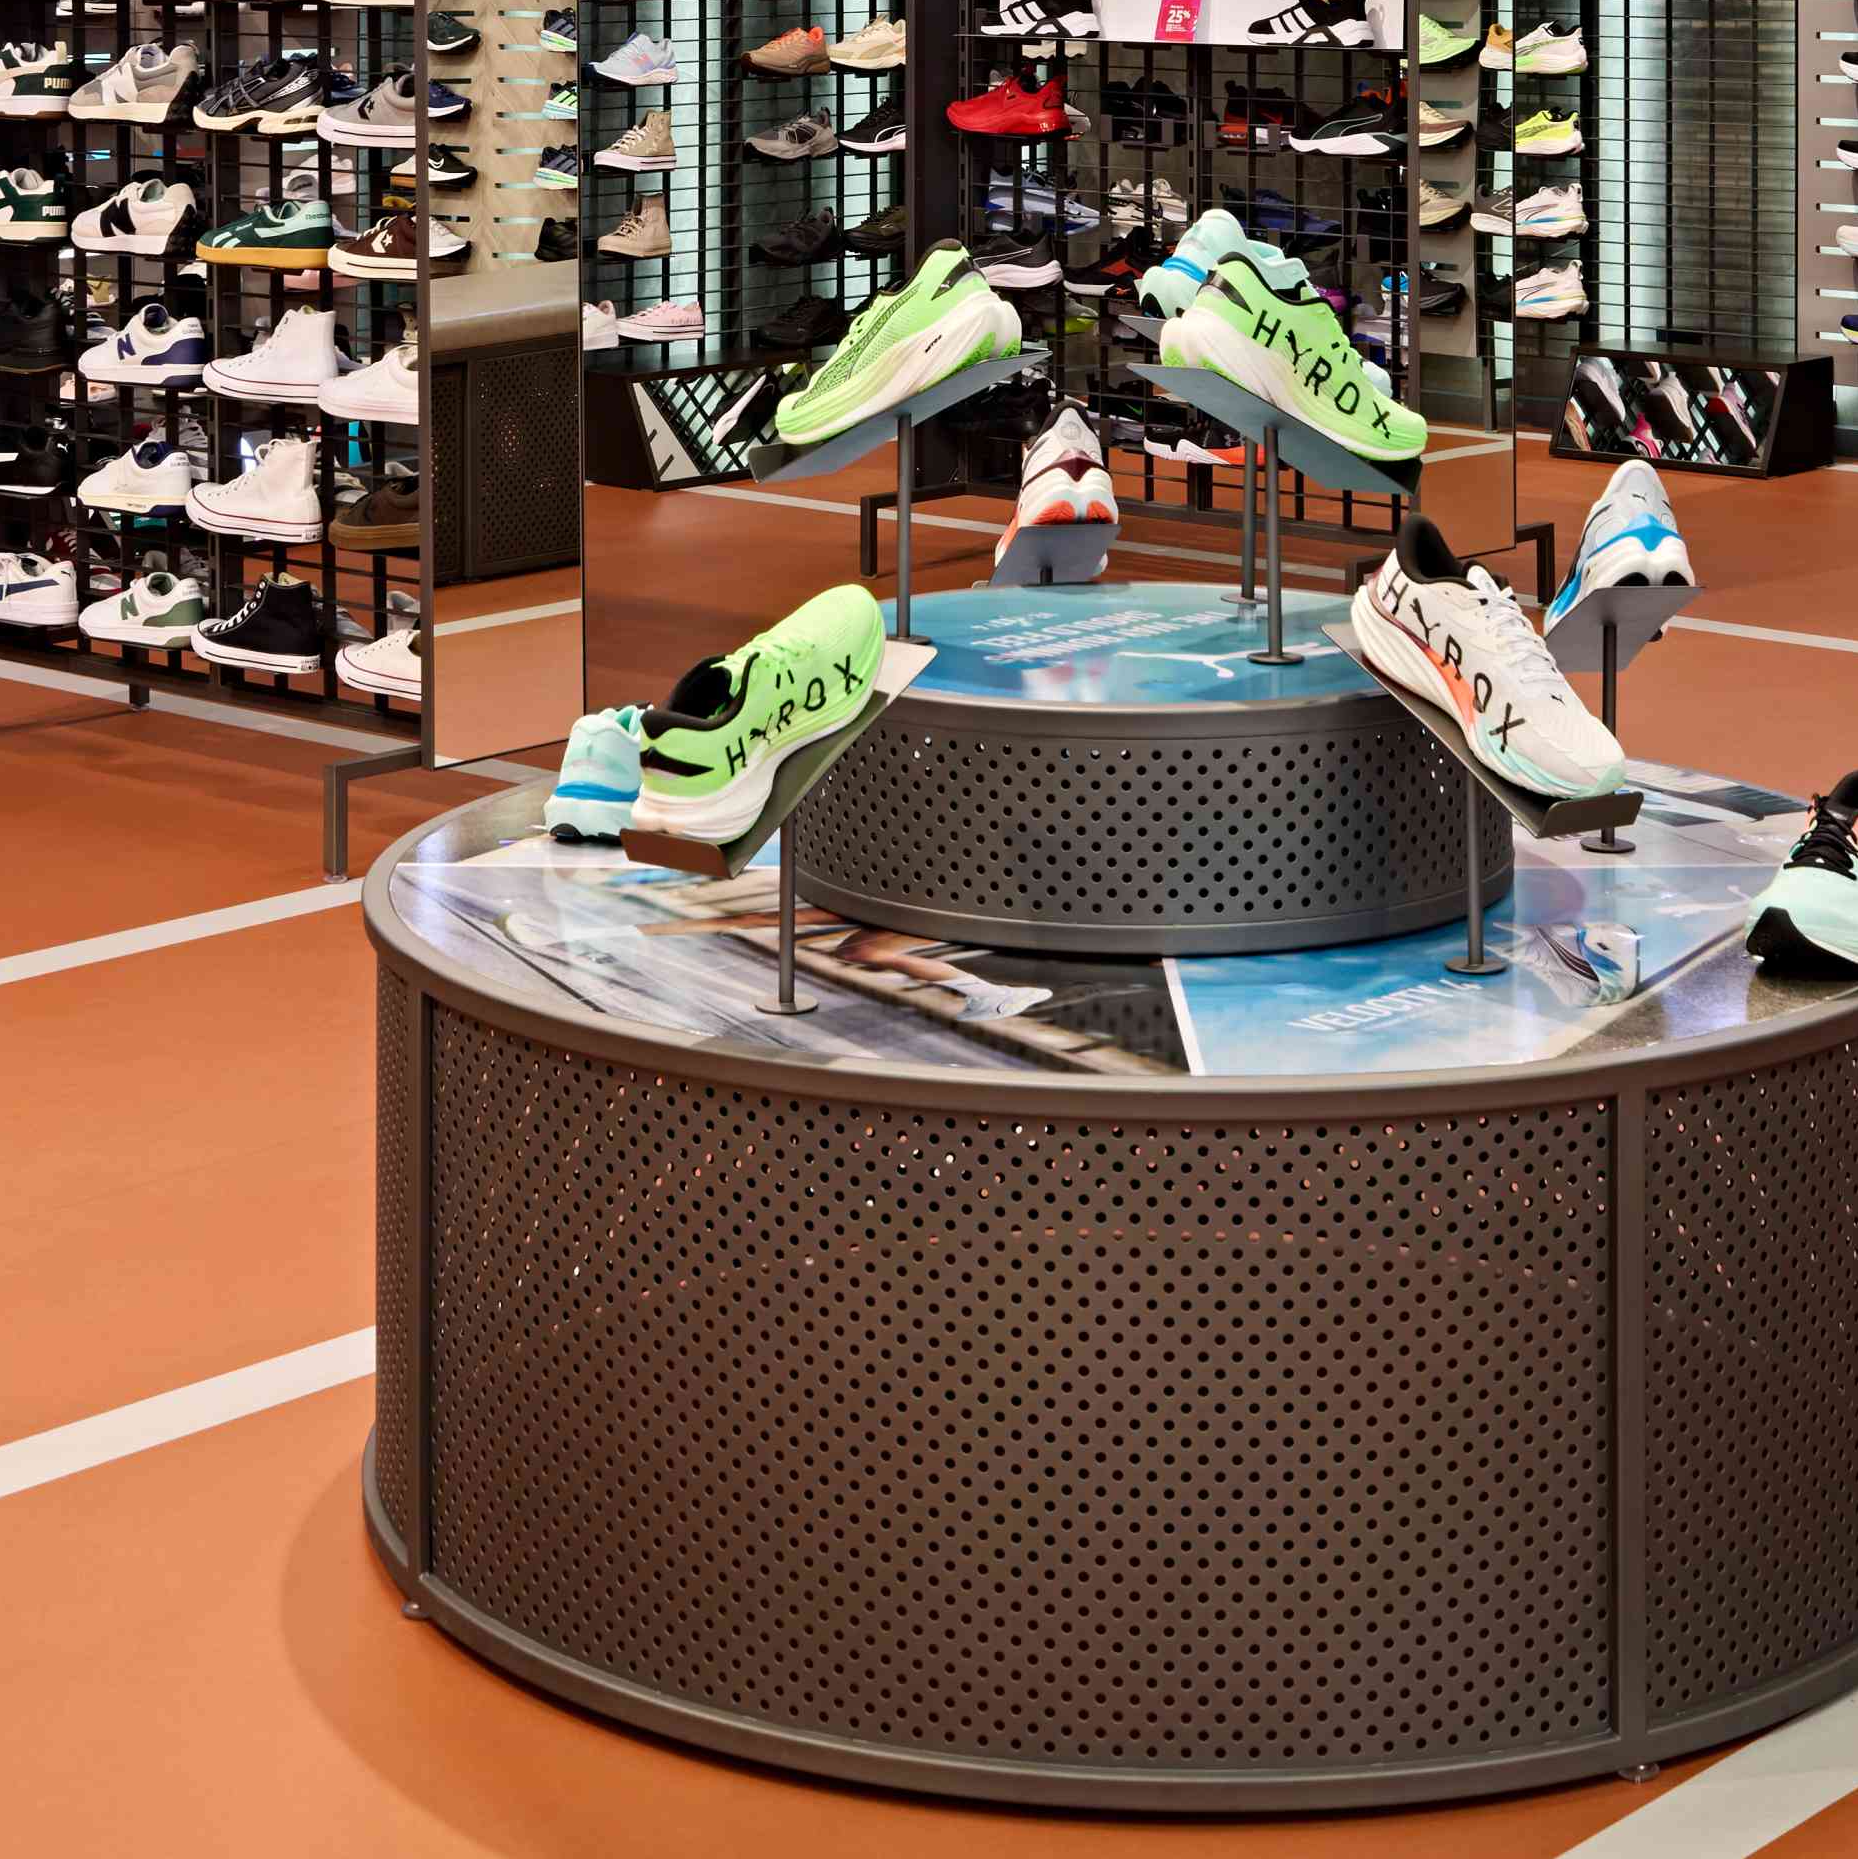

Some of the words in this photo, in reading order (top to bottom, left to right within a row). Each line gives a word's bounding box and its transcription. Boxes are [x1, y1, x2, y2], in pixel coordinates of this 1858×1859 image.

[1168, 9, 1191, 23] 25%
[44, 77, 72, 89] PUM
[42, 205, 67, 217] PUM
[1382, 569, 1526, 754] HYROX
[725, 654, 863, 777] HYROX
[1286, 984, 1454, 1032] VELOCITY
